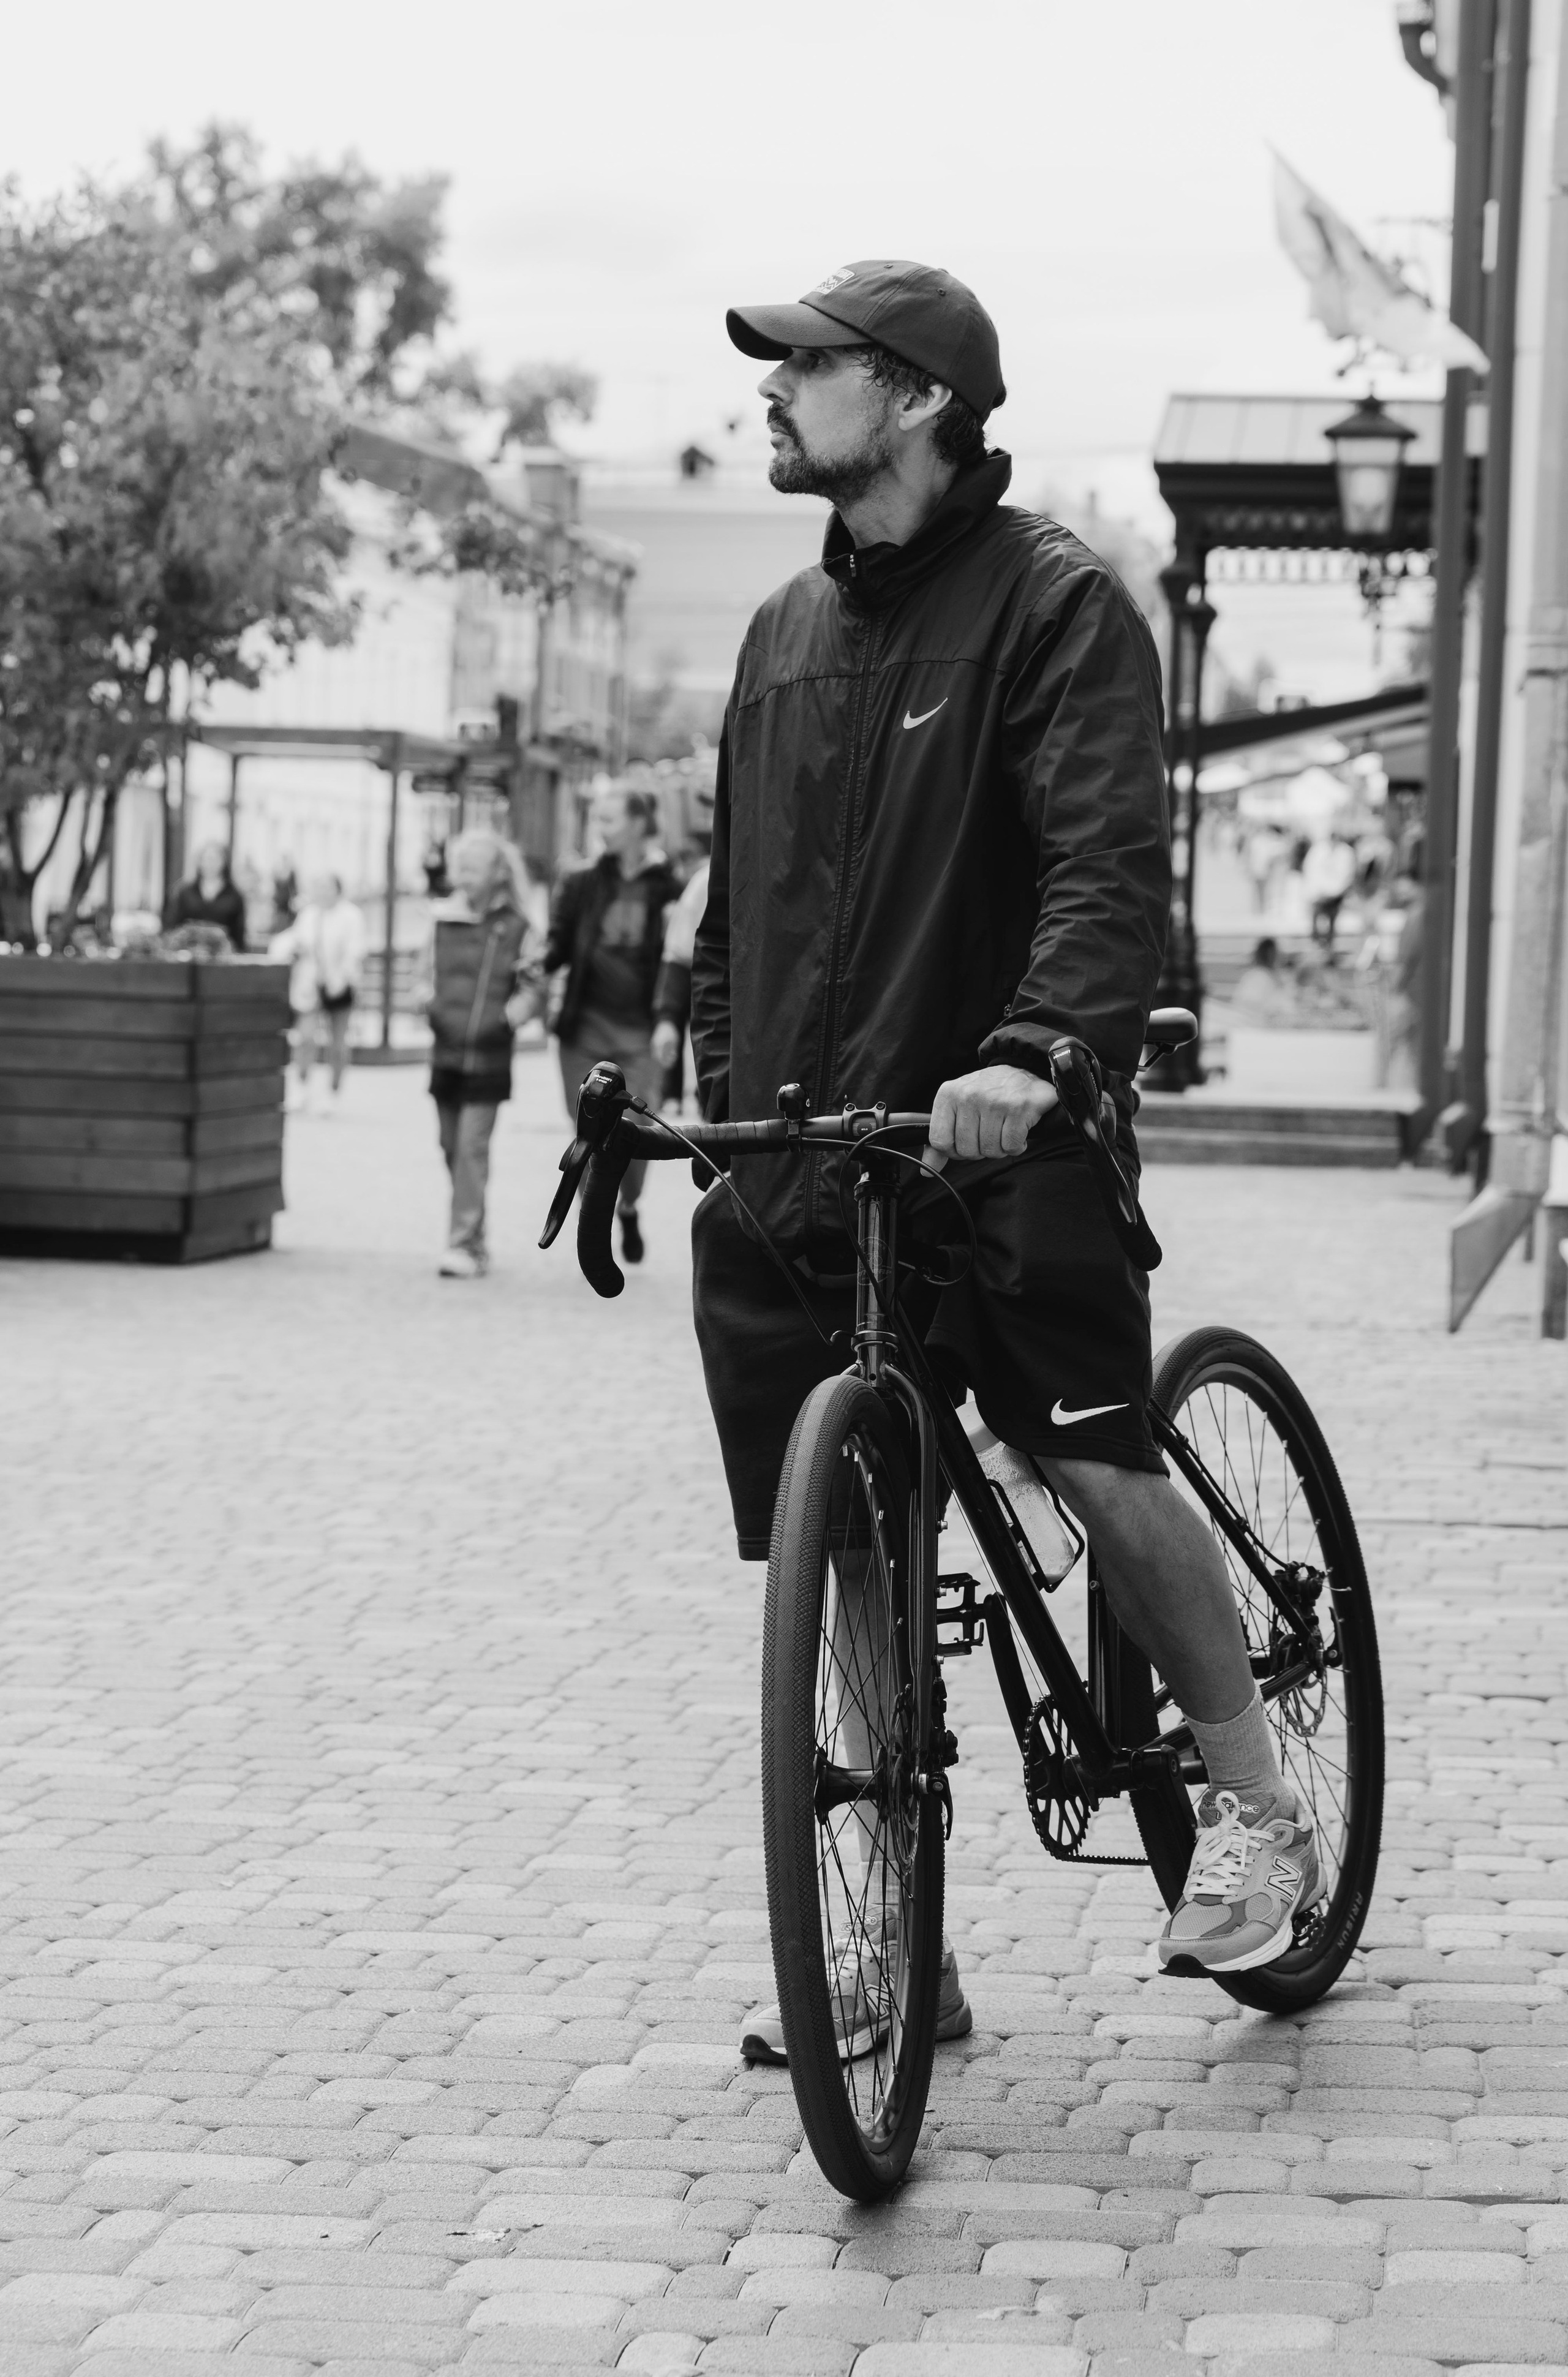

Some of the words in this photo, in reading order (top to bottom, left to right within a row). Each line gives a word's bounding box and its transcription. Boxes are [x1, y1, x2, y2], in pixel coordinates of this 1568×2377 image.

[1221, 1802, 1259, 1813] alnce
[1264, 1855, 1302, 1902] N
[1337, 1891, 1363, 1949] ARISUN
